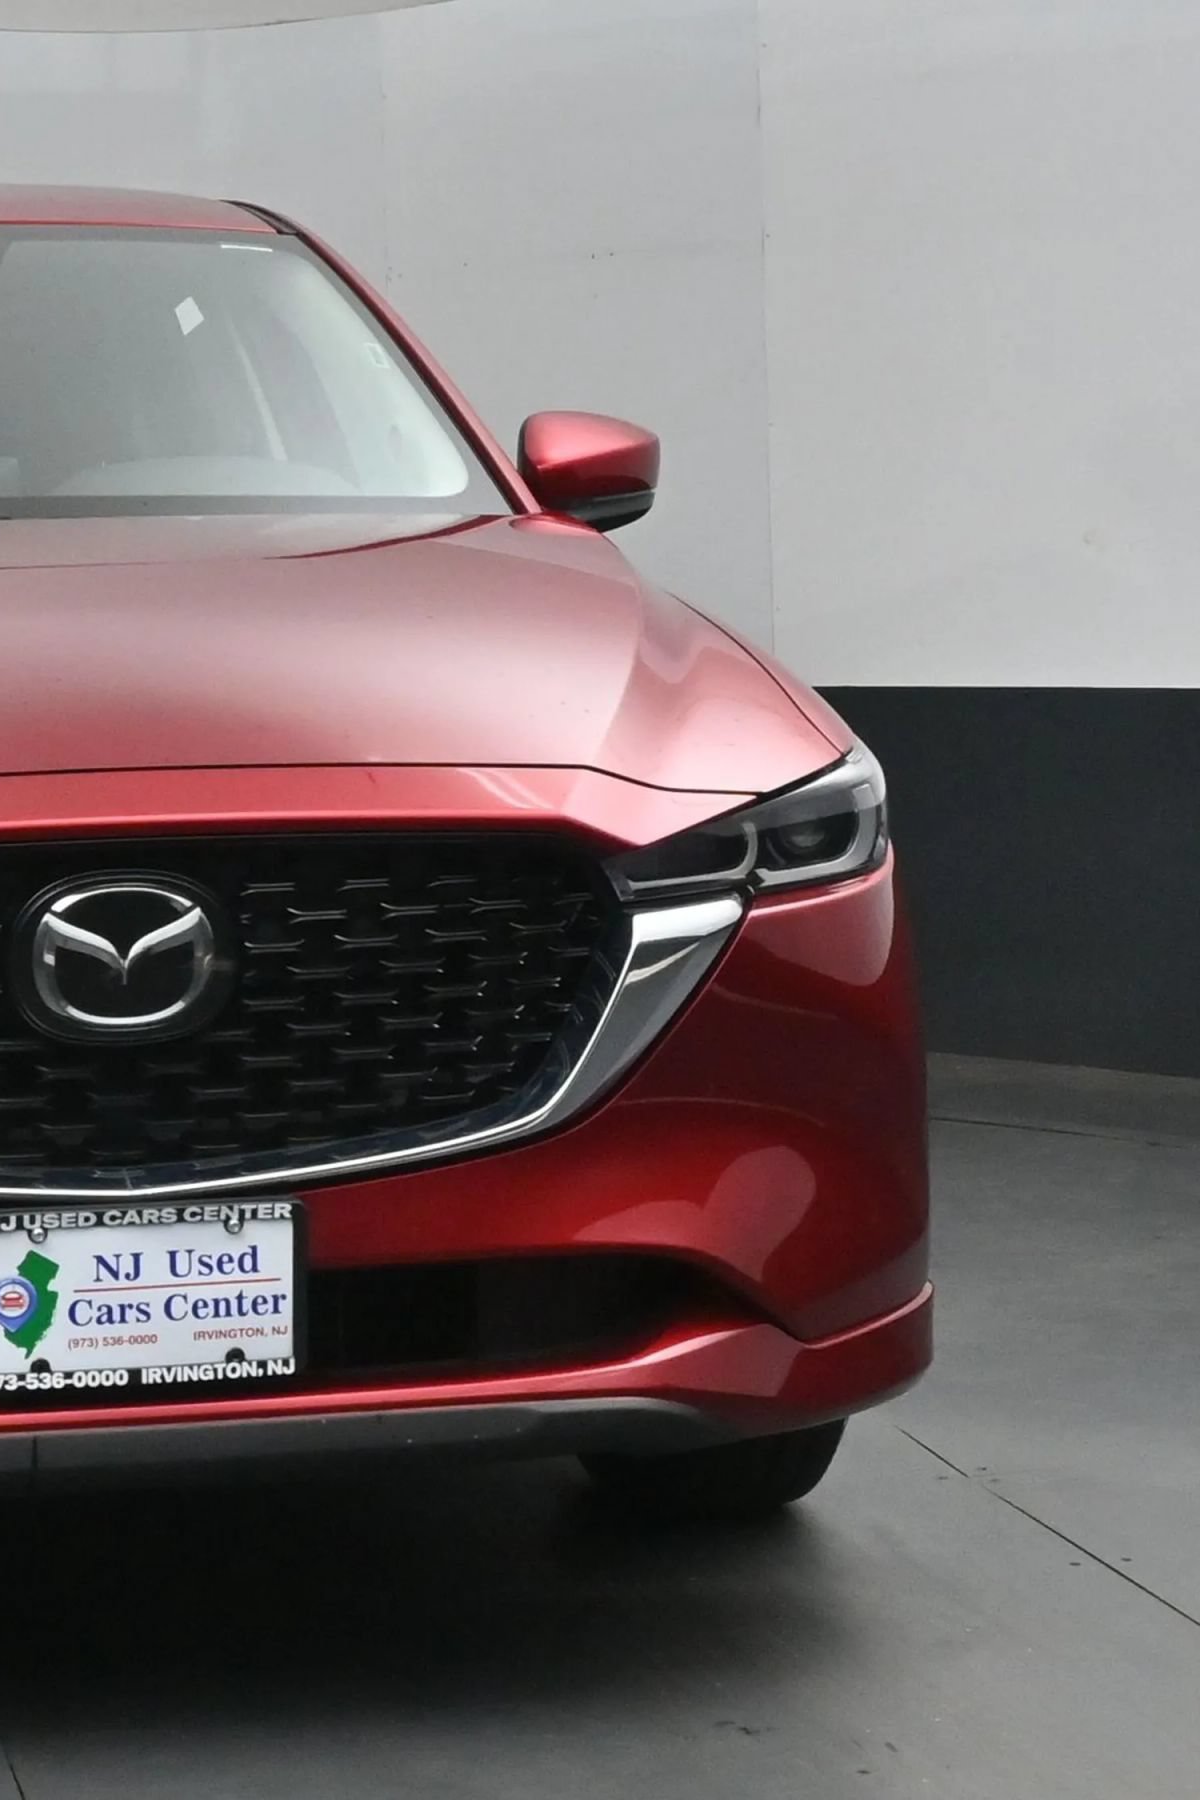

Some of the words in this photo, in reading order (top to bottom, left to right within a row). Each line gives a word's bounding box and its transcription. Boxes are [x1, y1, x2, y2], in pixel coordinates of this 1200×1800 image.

[23, 1211, 97, 1230] USED
[103, 1208, 178, 1226] CARS
[183, 1202, 293, 1222] CENTER
[93, 1251, 144, 1282] NJ
[167, 1245, 260, 1278] Used
[67, 1299, 151, 1326] Cars
[163, 1289, 288, 1322] Center
[67, 1336, 99, 1350] (973)
[102, 1334, 158, 1347] 536-0000
[193, 1327, 268, 1341] IRVINGTON,
[272, 1325, 289, 1336] NJ
[141, 1361, 264, 1385] IRVINGTON,
[267, 1357, 296, 1376] NJ
